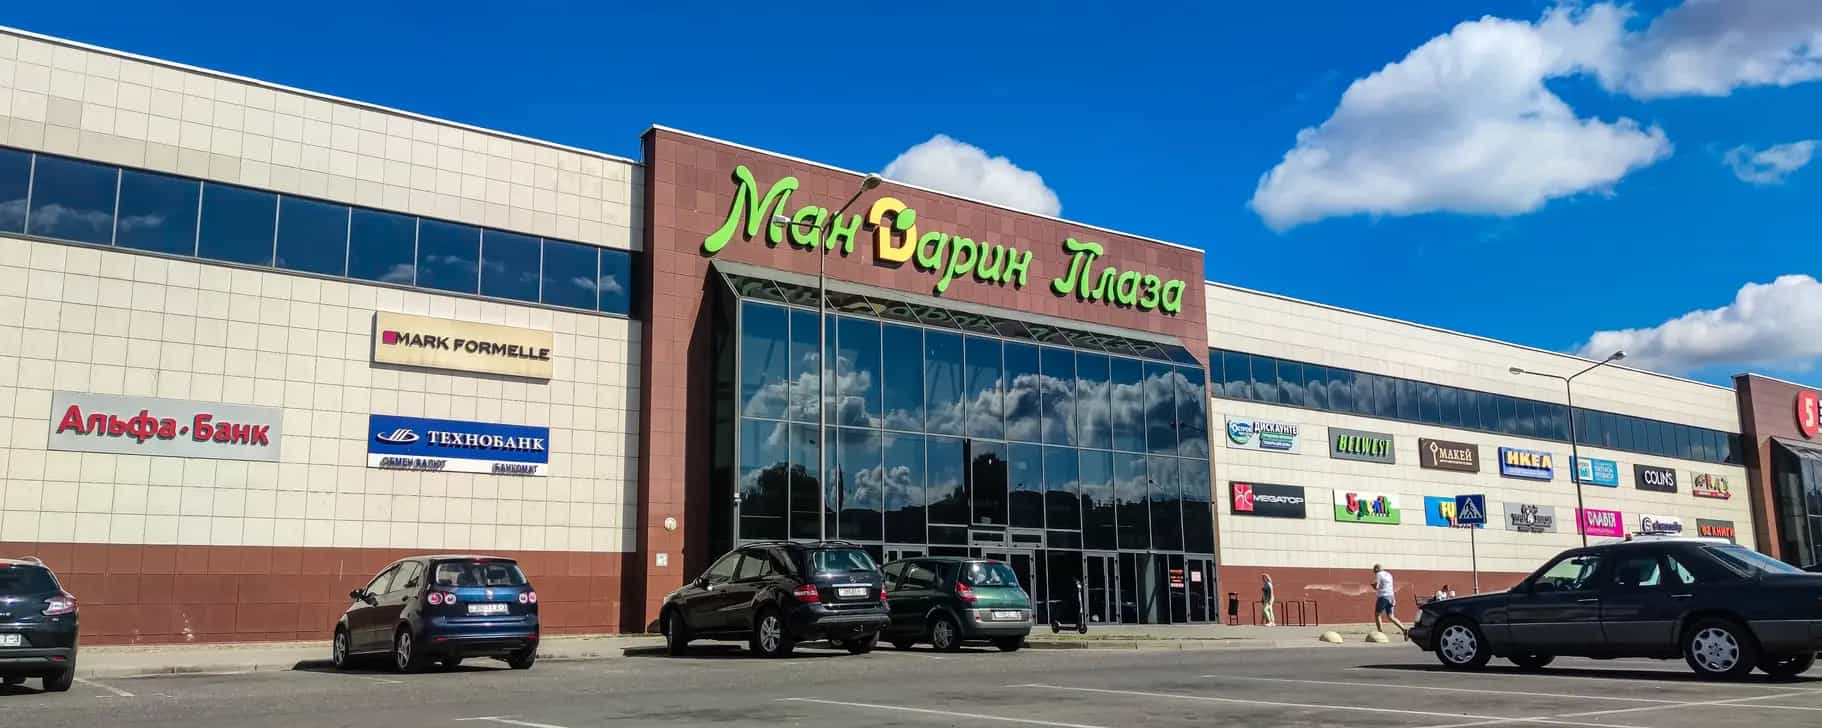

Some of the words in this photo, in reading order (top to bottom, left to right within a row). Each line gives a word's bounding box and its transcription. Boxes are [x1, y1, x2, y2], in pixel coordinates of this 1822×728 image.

[1052, 238, 1185, 313] Плаза
[395, 331, 449, 351] MARK
[453, 338, 550, 361] FORMELLE
[427, 430, 545, 451] ТЕХНОБАНК
[1338, 434, 1391, 457] BELWEST
[1439, 447, 1473, 462] МАКЕЙ
